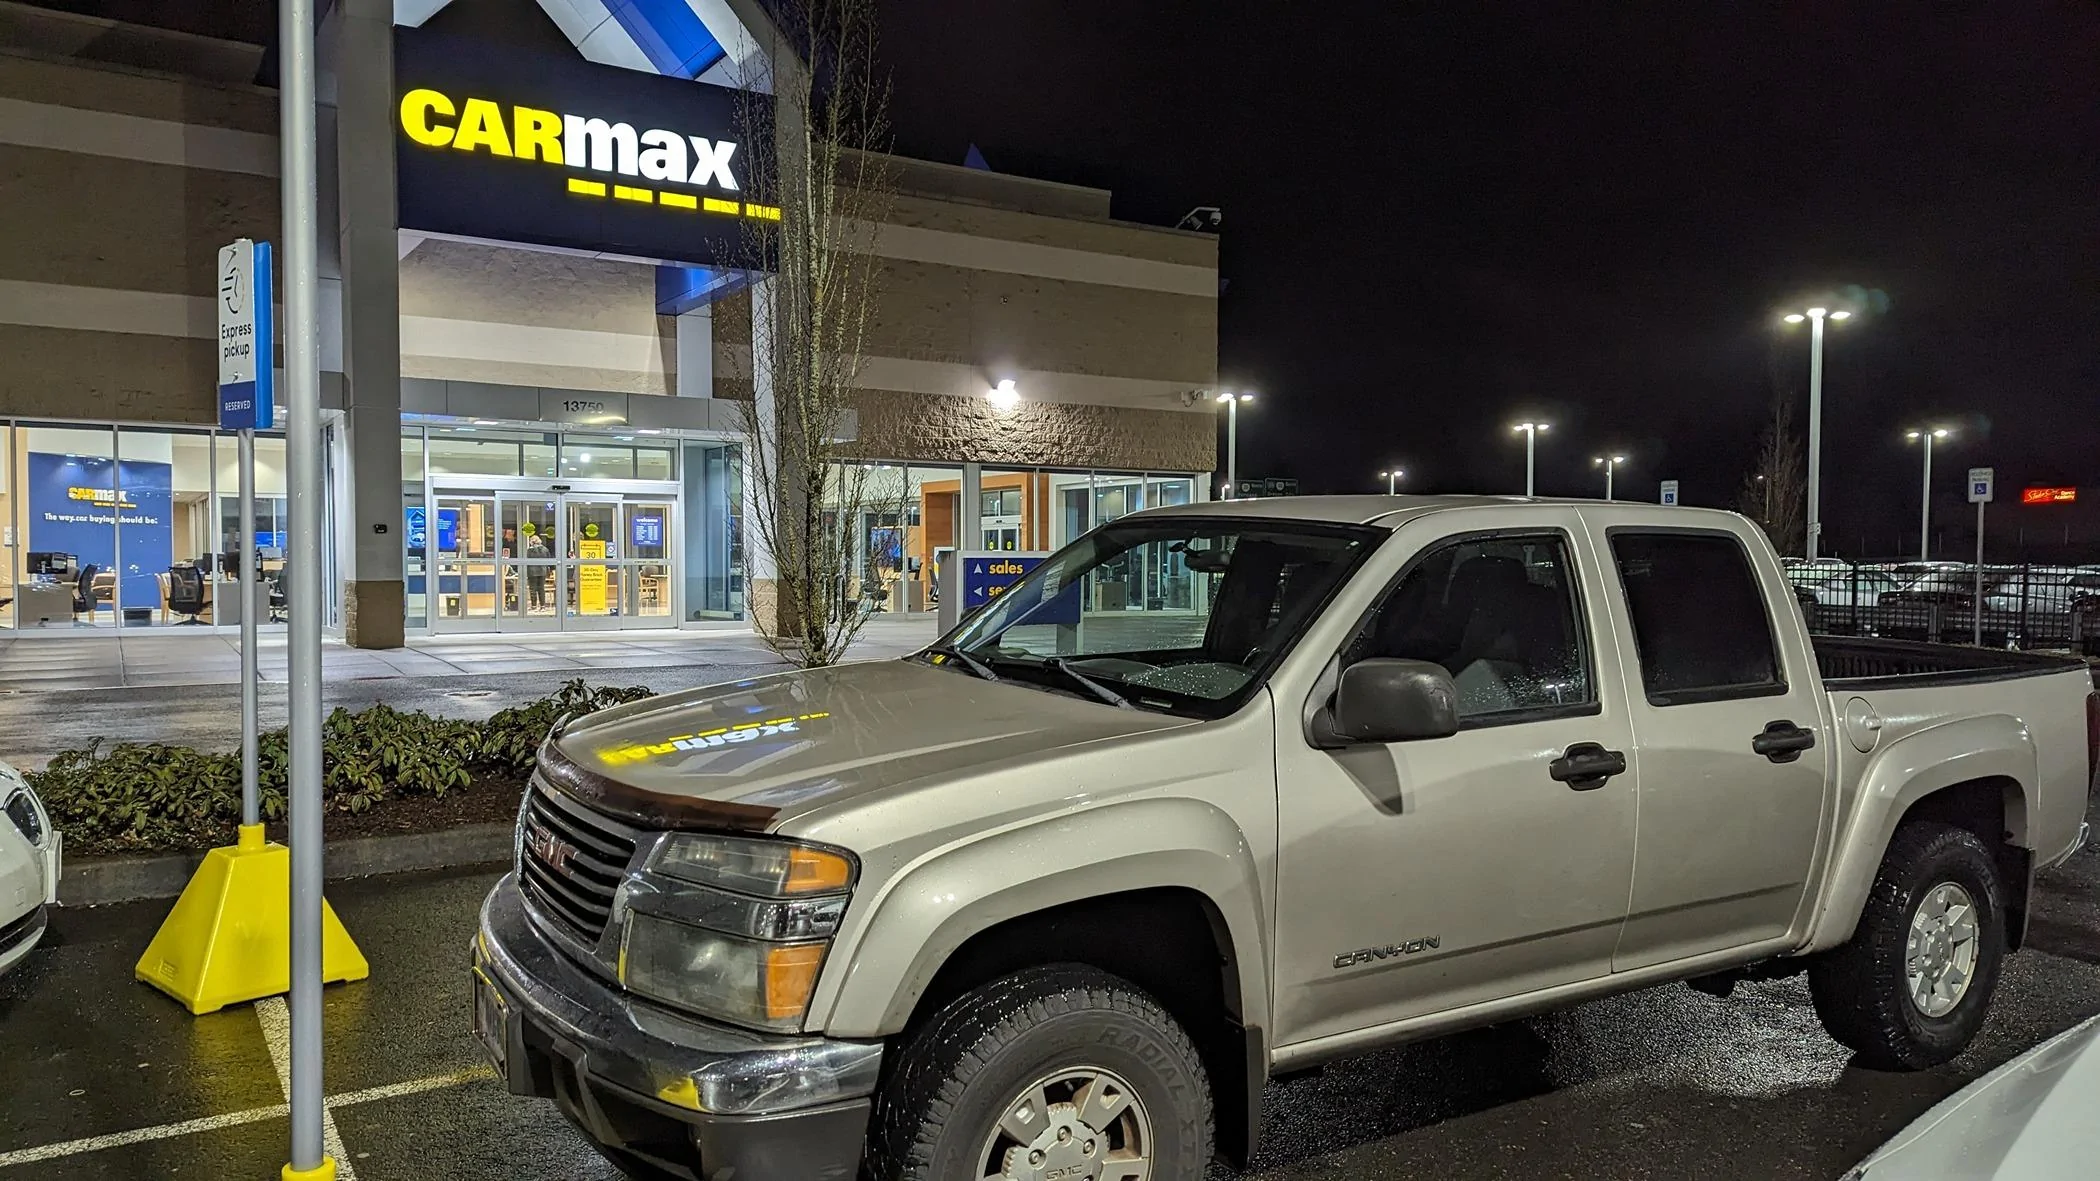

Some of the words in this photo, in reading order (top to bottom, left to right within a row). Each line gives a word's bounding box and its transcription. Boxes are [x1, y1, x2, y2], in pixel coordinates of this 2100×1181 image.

[400, 88, 739, 191] CARmax
[221, 322, 252, 340] Express
[224, 342, 250, 361] pickup
[224, 399, 251, 411] RESERVED
[563, 400, 604, 412] 13750
[90, 514, 115, 524] buying
[989, 559, 1024, 574] sales
[535, 825, 580, 880] GMC
[1333, 935, 1440, 968] CANYON
[1098, 1023, 1187, 1100] RADIAL
[1046, 1164, 1082, 1180] GMC
